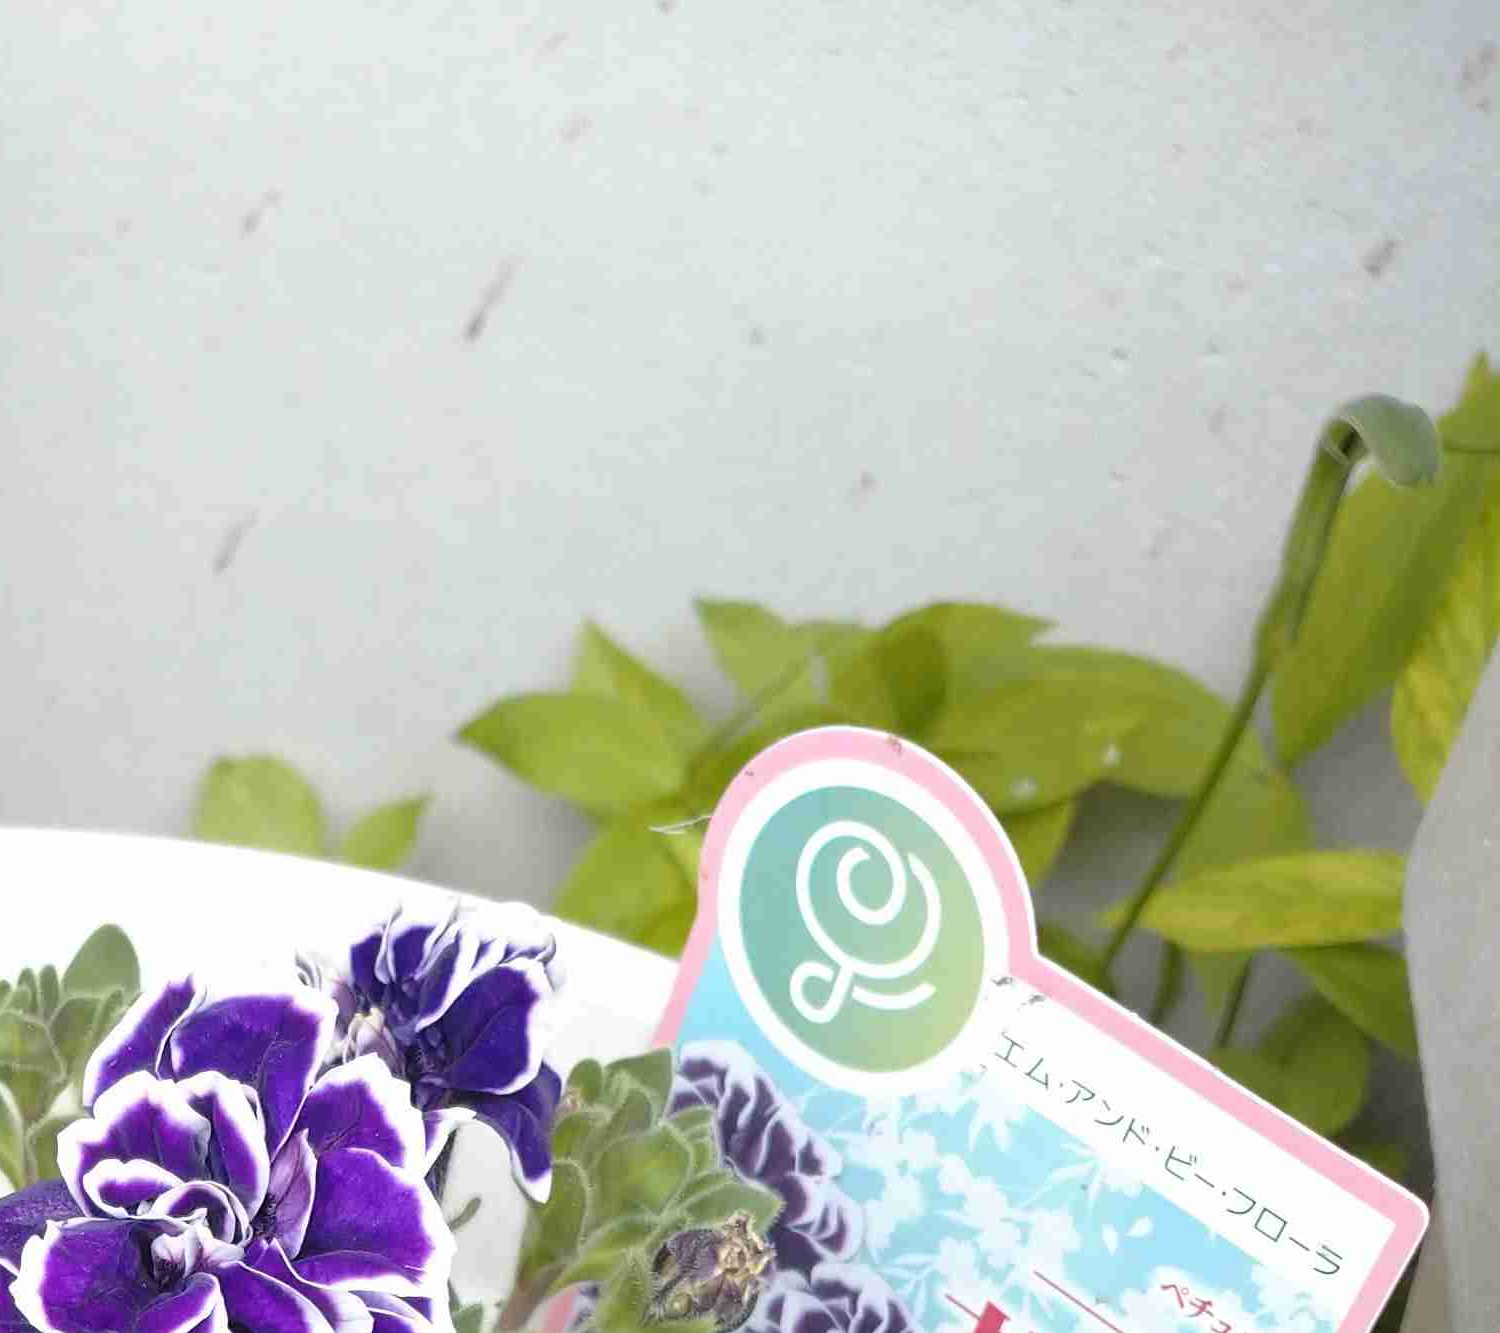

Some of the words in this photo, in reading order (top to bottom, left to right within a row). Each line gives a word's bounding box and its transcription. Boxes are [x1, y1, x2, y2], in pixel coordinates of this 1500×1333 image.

[994, 1030, 1343, 1275] エム・アンド・ビー・フローラ
